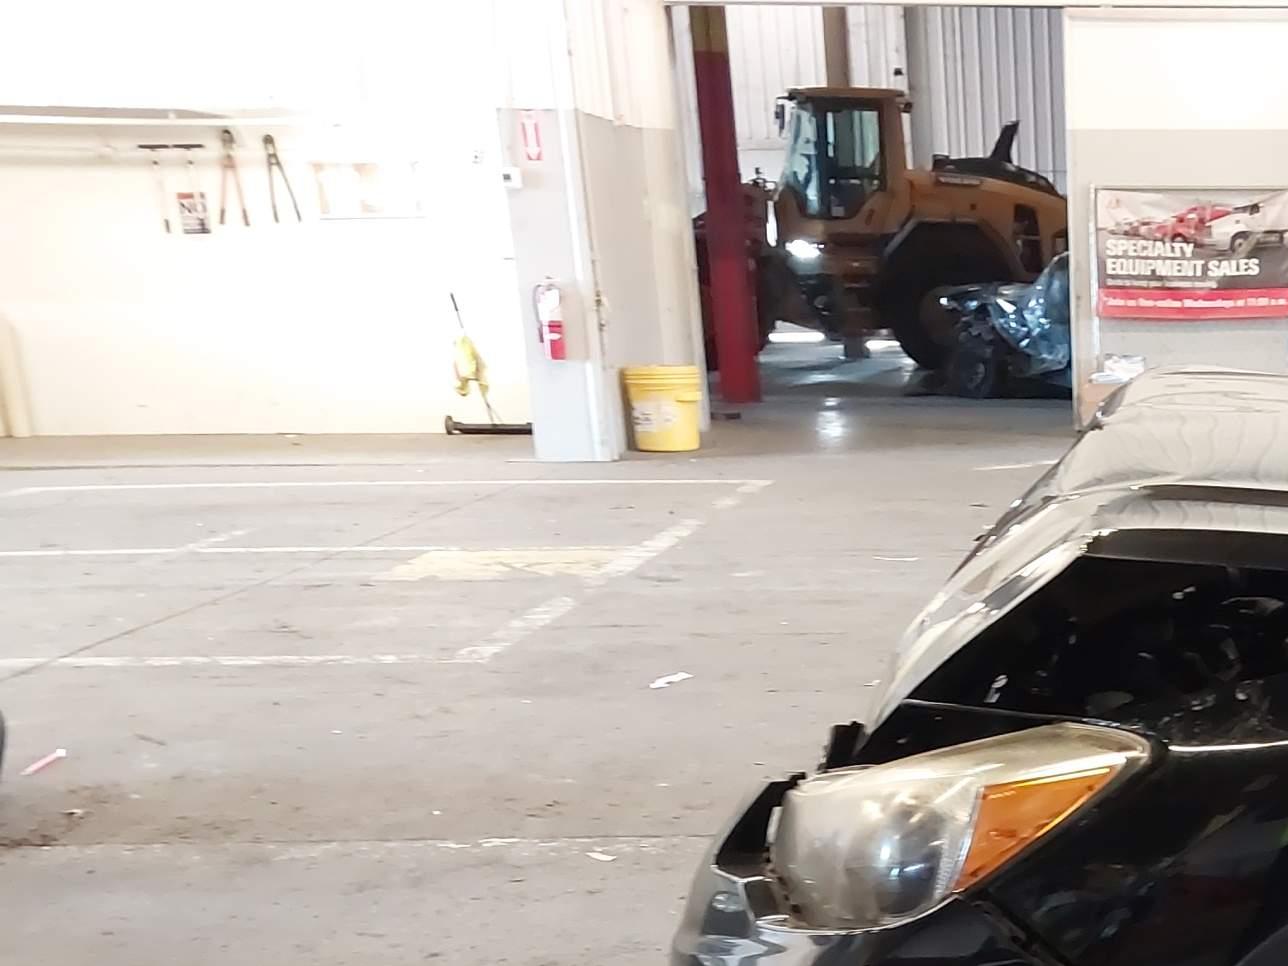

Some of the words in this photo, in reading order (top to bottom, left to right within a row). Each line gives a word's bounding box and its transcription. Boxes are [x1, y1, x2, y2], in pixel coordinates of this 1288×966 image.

[1105, 240, 1195, 257] SPECIALTY
[1106, 258, 1205, 276] EQUIPMENT
[1207, 258, 1260, 277] SALES
